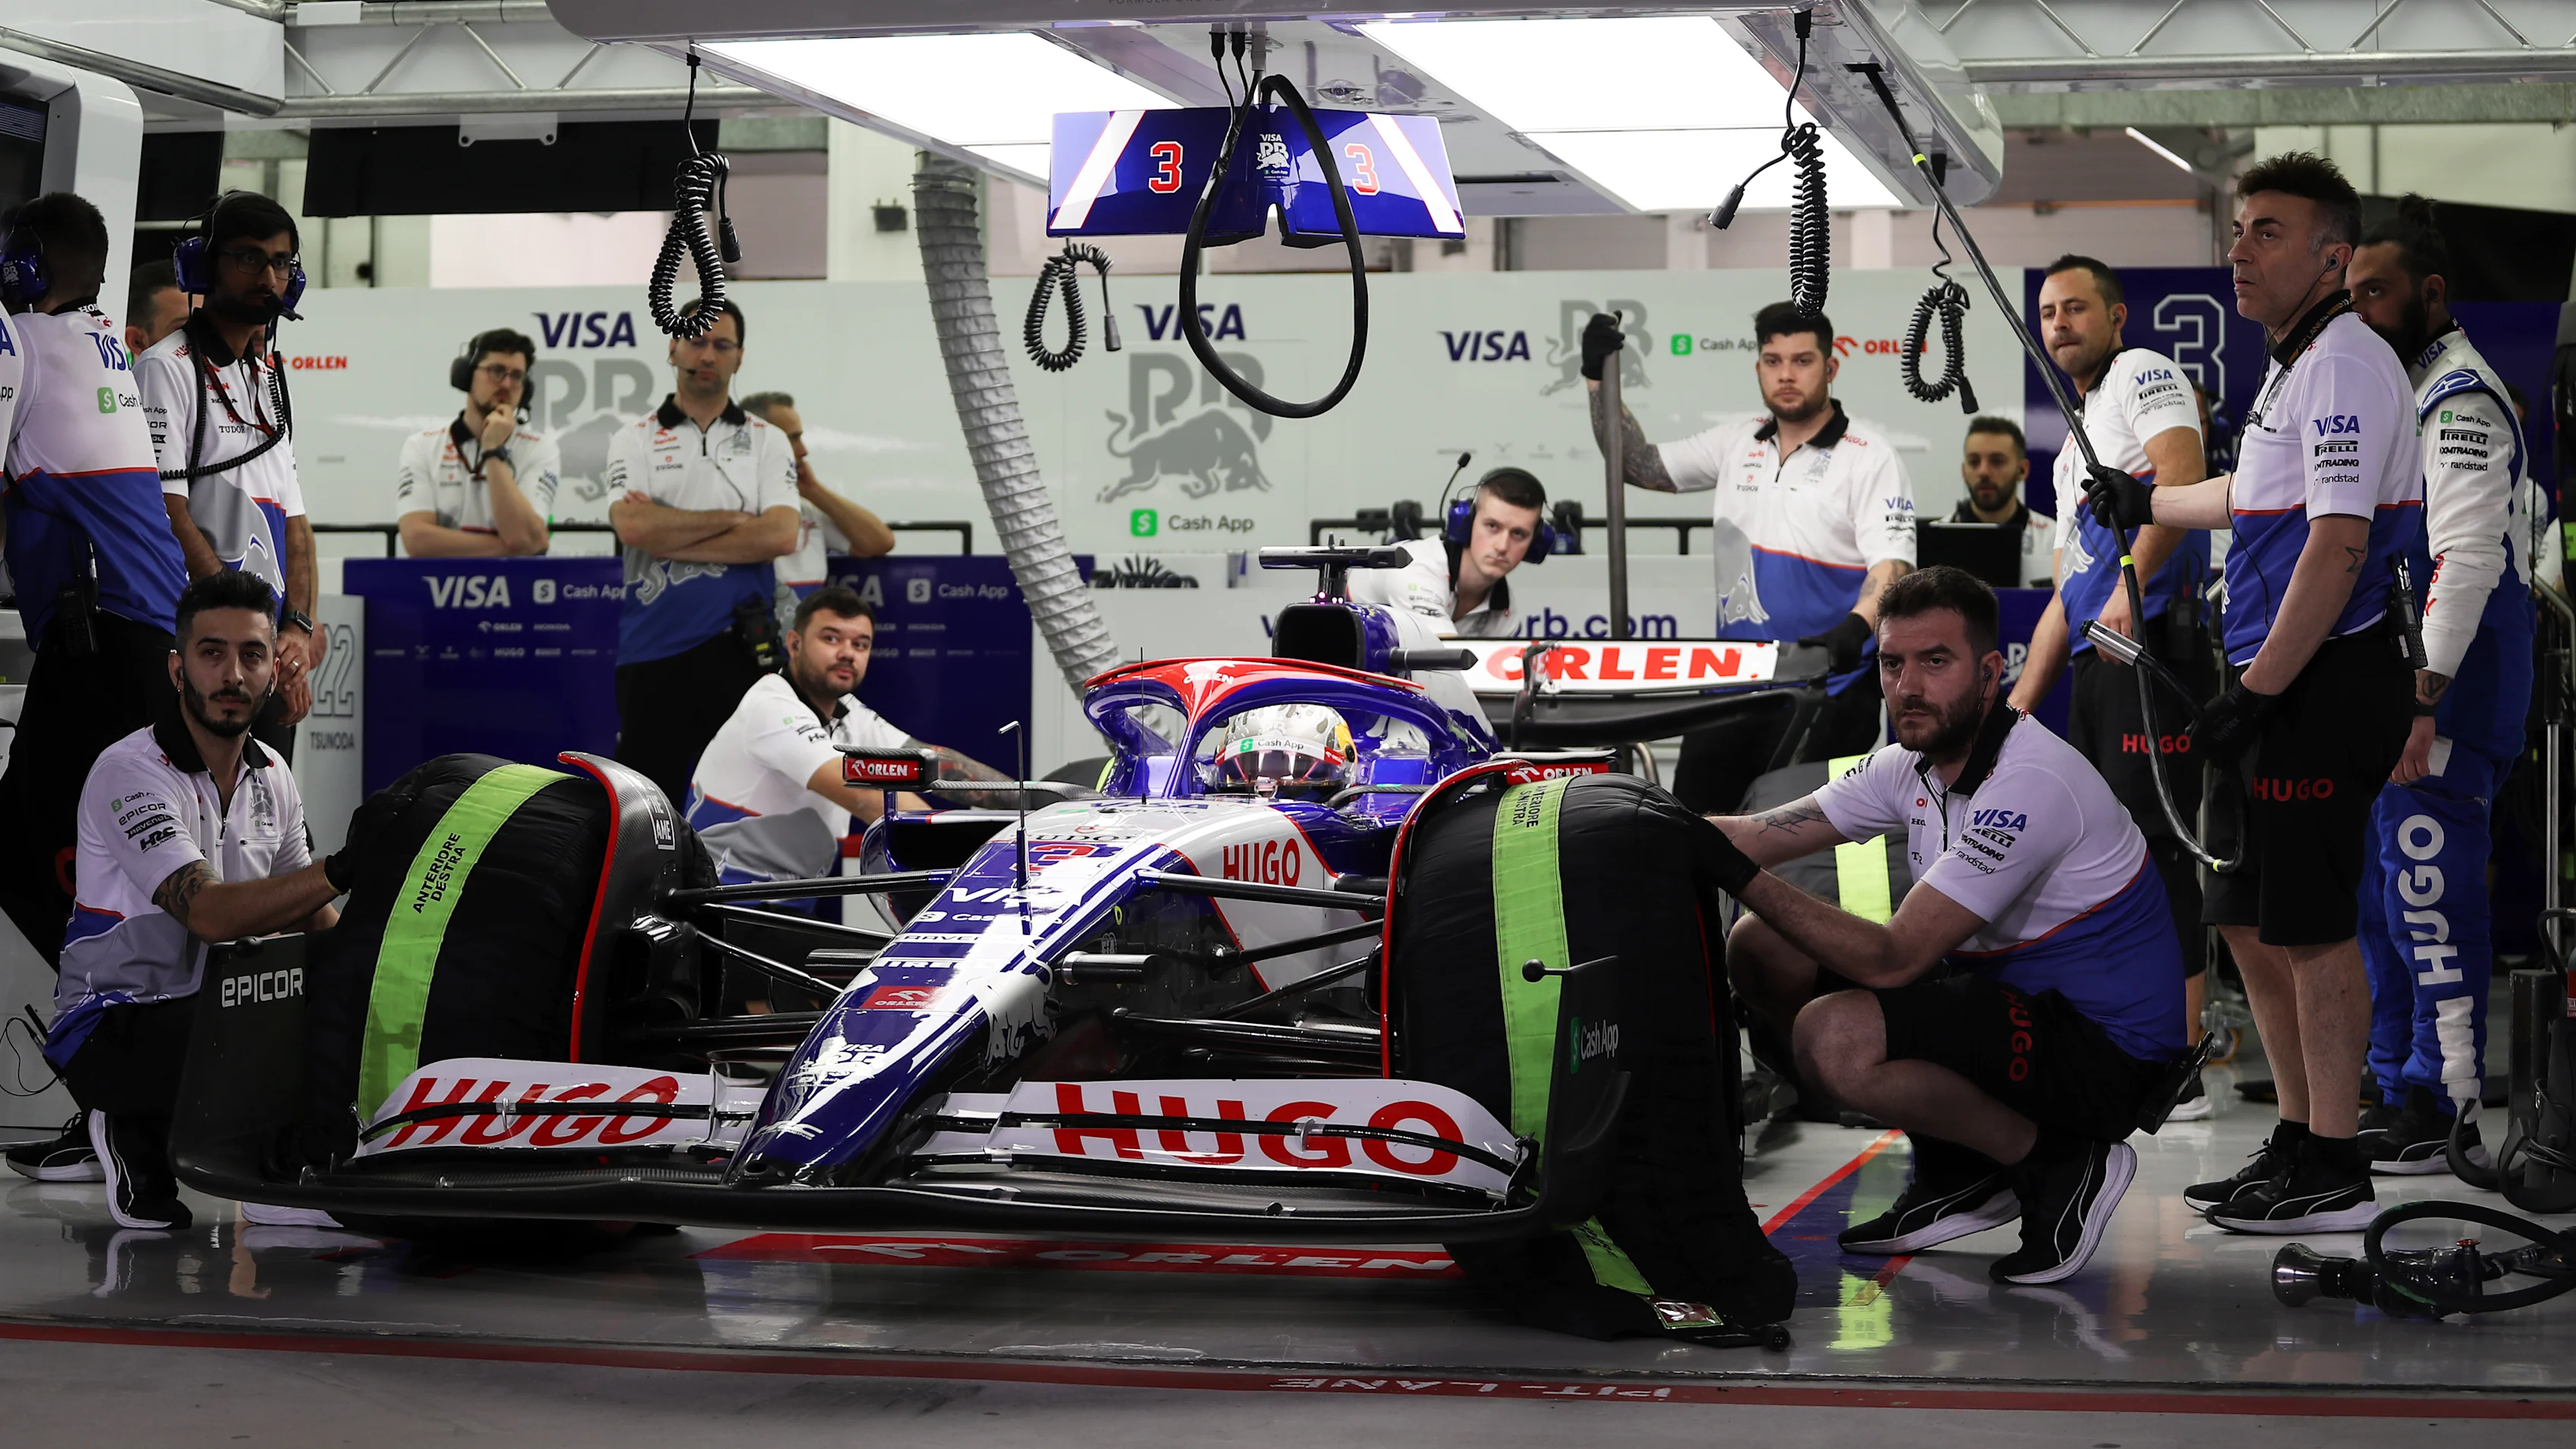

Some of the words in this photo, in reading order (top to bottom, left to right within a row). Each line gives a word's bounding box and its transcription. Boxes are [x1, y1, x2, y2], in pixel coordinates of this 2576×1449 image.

[1259, 134, 1282, 142] VISA
[1148, 140, 1184, 194] 3
[1344, 143, 1381, 196] 3
[532, 311, 637, 348] VISA
[1133, 303, 1246, 340] VISA
[1700, 338, 1735, 350] Cash
[1737, 337, 1757, 352] Ap
[2298, 338, 2310, 349] PIT
[2306, 319, 2324, 339] LANE
[84, 333, 131, 371] VIS
[1436, 330, 1531, 361] VISA
[1864, 339, 1927, 355] ORL
[2154, 294, 2225, 401] 3
[2416, 340, 2448, 369] VISA
[292, 356, 348, 369] ORLEN
[2134, 369, 2174, 385] VISA
[0, 386, 14, 402] pp
[119, 393, 138, 407] Cash
[2138, 384, 2178, 400] PIRELLI
[153, 406, 168, 415] App
[2154, 399, 2186, 410] randstad
[219, 425, 246, 434] TUDOR
[2312, 415, 2360, 437] VISA
[2456, 415, 2474, 423] Cash
[2477, 418, 2491, 427] App
[1842, 434, 1868, 447] HUGO
[2440, 429, 2489, 445] PIRELLI
[2451, 461, 2488, 471] randstad
[2322, 473, 2360, 484] randstad
[1168, 515, 1211, 530] Cash
[1217, 515, 1255, 533] App
[421, 575, 510, 608] VISA
[563, 584, 598, 598] Cash
[835, 574, 884, 607] SA
[939, 583, 974, 598] Cash
[977, 583, 1009, 599] App
[311, 623, 355, 717] 22
[1486, 647, 1742, 681] ORLEN
[310, 731, 355, 750] TSUNODA
[1284, 740, 1304, 750] App
[2122, 734, 2191, 754] HUGO
[867, 763, 908, 776] ORLEN
[1543, 767, 1593, 781] ORLEN
[125, 791, 144, 803] Cash
[2252, 778, 2334, 801] HUGO
[1973, 809, 2028, 832] VISA
[1971, 828, 2016, 848] RELLI
[412, 832, 461, 914] ANTERIORE
[1223, 838, 1301, 887] HUGO
[1956, 851, 1997, 875] randstad
[430, 847, 466, 902] DESTRA
[2398, 814, 2464, 986] HUGO
[1580, 1021, 1601, 1060] Cash
[1601, 1019, 1619, 1059] App
[2000, 989, 2032, 1082] HUGO
[384, 1075, 680, 1148] HUGO
[1053, 1083, 1464, 1176] HUGO
[1034, 1249, 1457, 1271] ORLEN
